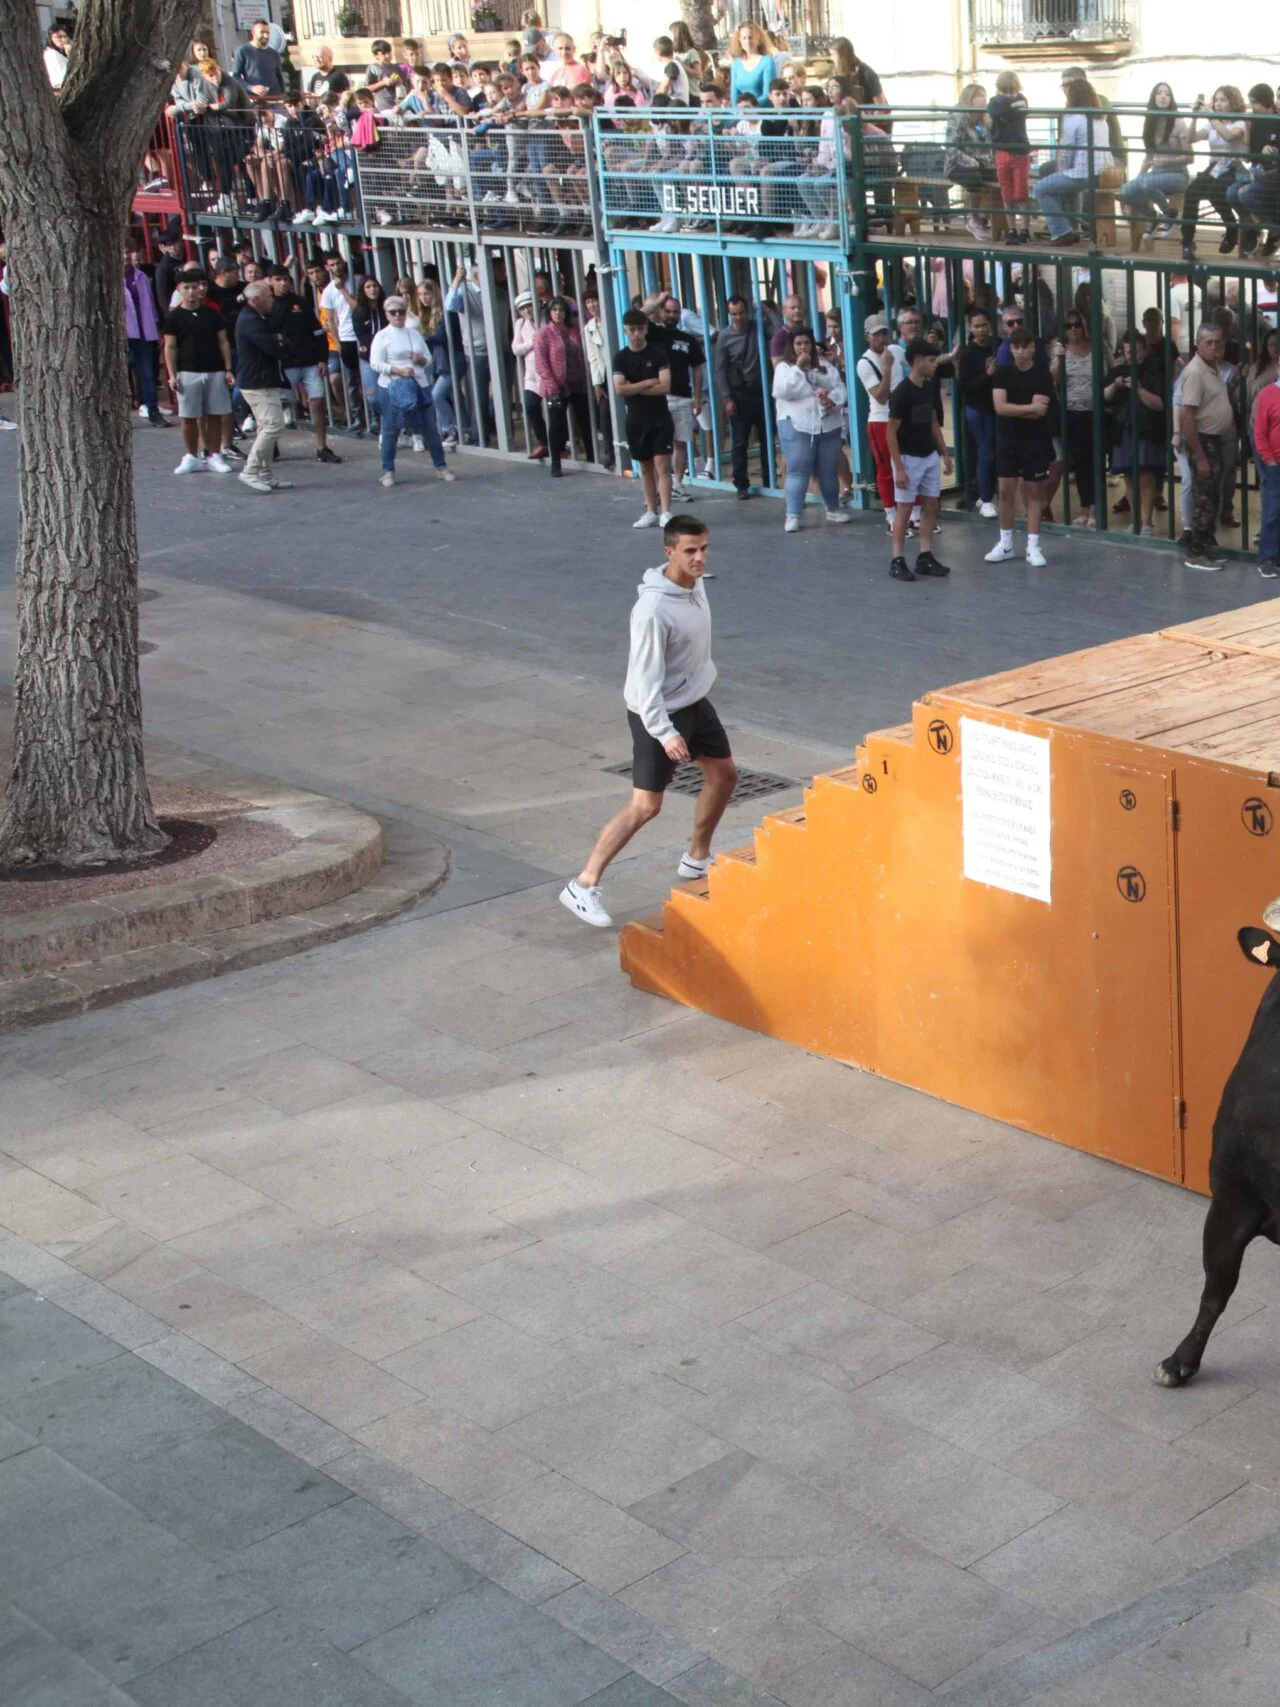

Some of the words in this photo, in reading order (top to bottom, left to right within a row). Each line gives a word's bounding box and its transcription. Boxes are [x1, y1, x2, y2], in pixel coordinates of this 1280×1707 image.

[687, 185, 760, 215] SEQUER
[930, 722, 949, 753] TN
[1243, 802, 1268, 833] TN
[1119, 870, 1141, 900] TN
